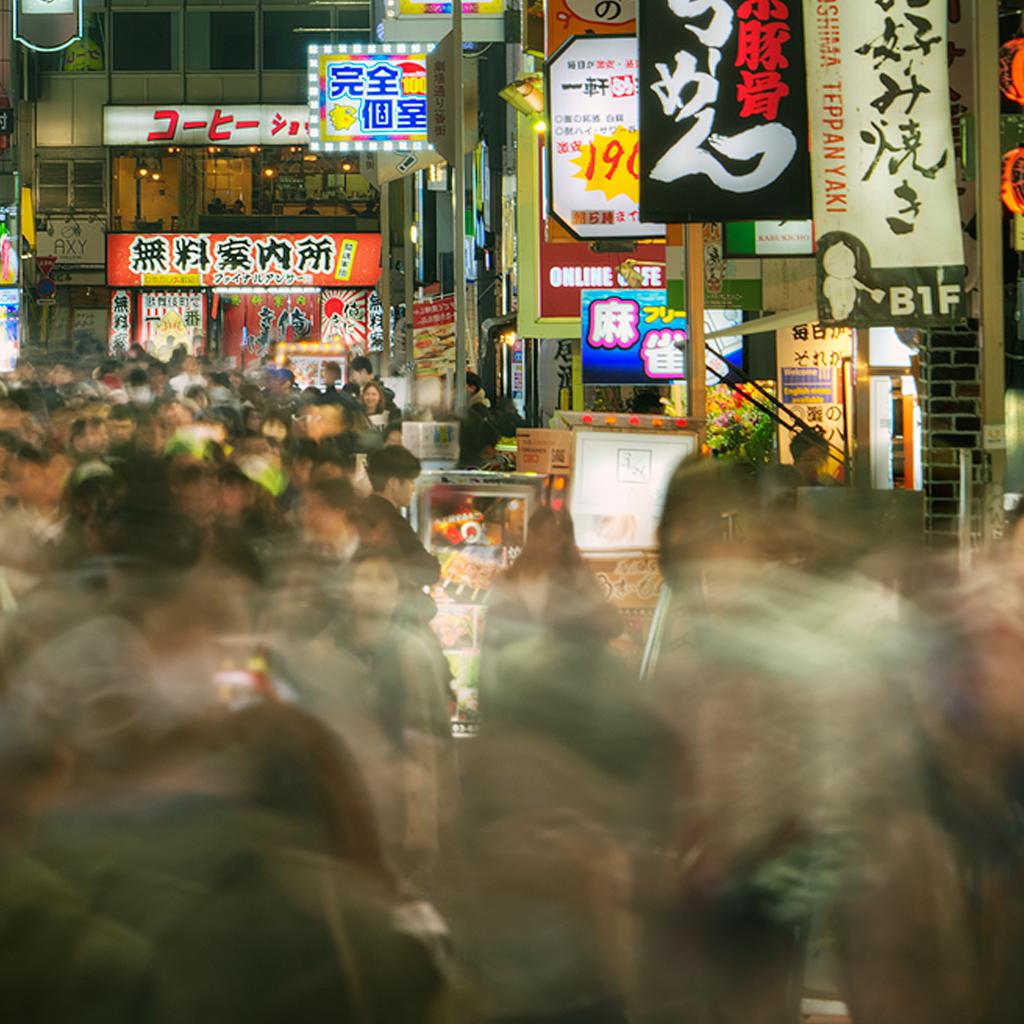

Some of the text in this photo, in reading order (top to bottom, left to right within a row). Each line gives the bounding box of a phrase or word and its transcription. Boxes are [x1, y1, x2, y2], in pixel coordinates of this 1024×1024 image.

[593, 0, 622, 21] の
[330, 65, 400, 97] 完全
[146, 108, 309, 141] コーヒー ショ
[363, 98, 427, 129] 個室
[757, 233, 811, 243] KABUKICHO
[130, 237, 335, 274] 無料案内所
[549, 266, 614, 288] ONLINE
[888, 285, 961, 316] B1F
[593, 301, 687, 378] 麻雀
